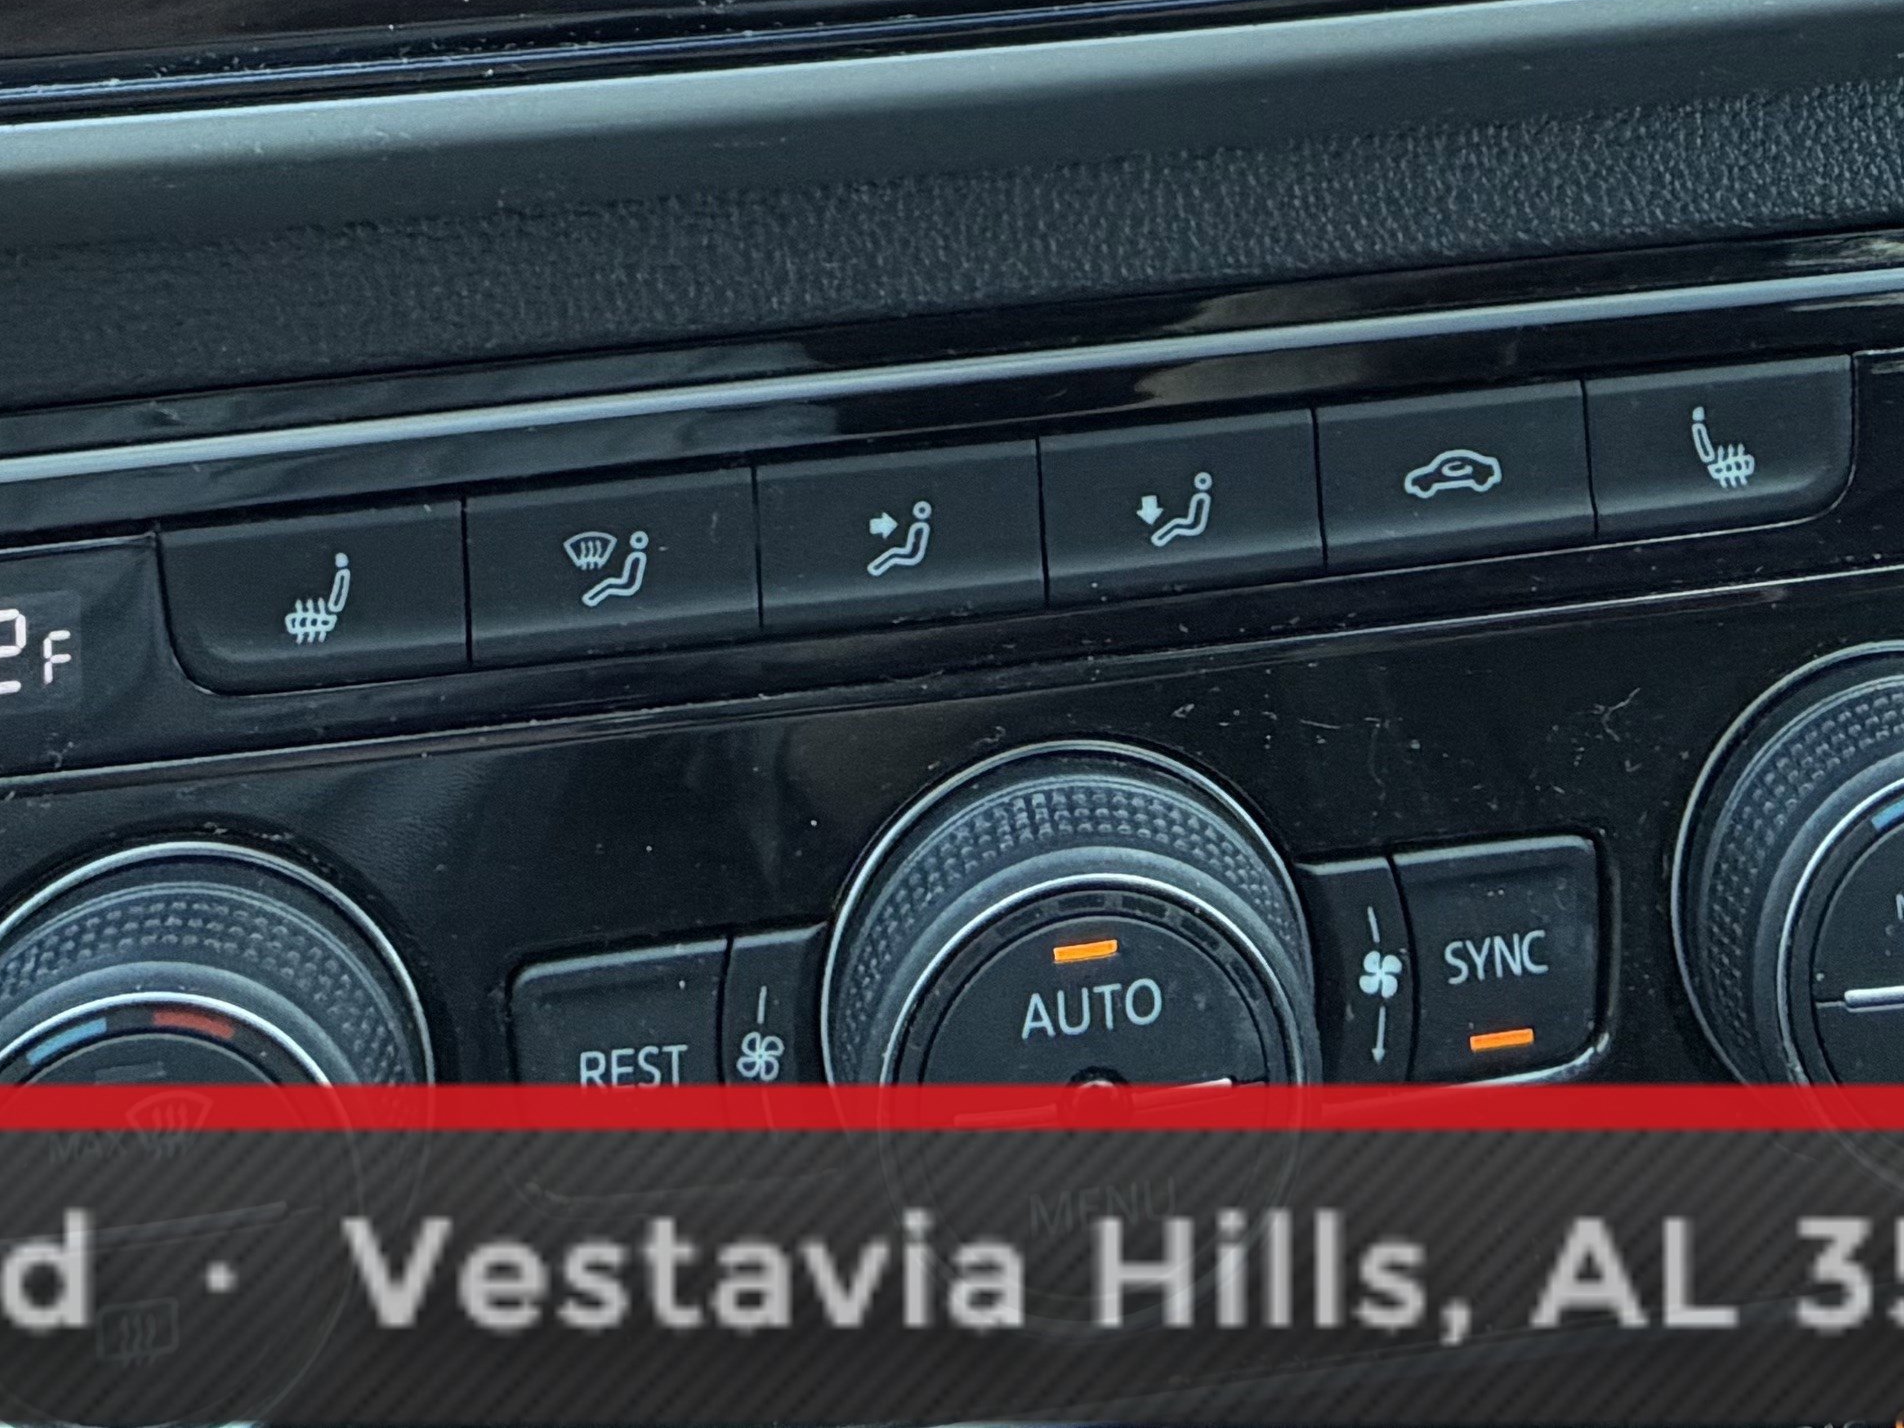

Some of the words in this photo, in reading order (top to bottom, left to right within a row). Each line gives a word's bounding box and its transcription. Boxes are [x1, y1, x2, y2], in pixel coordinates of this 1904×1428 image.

[1443, 929, 1549, 986] SYNC
[1020, 977, 1164, 1041] AUTO
[579, 1043, 689, 1092] REST
